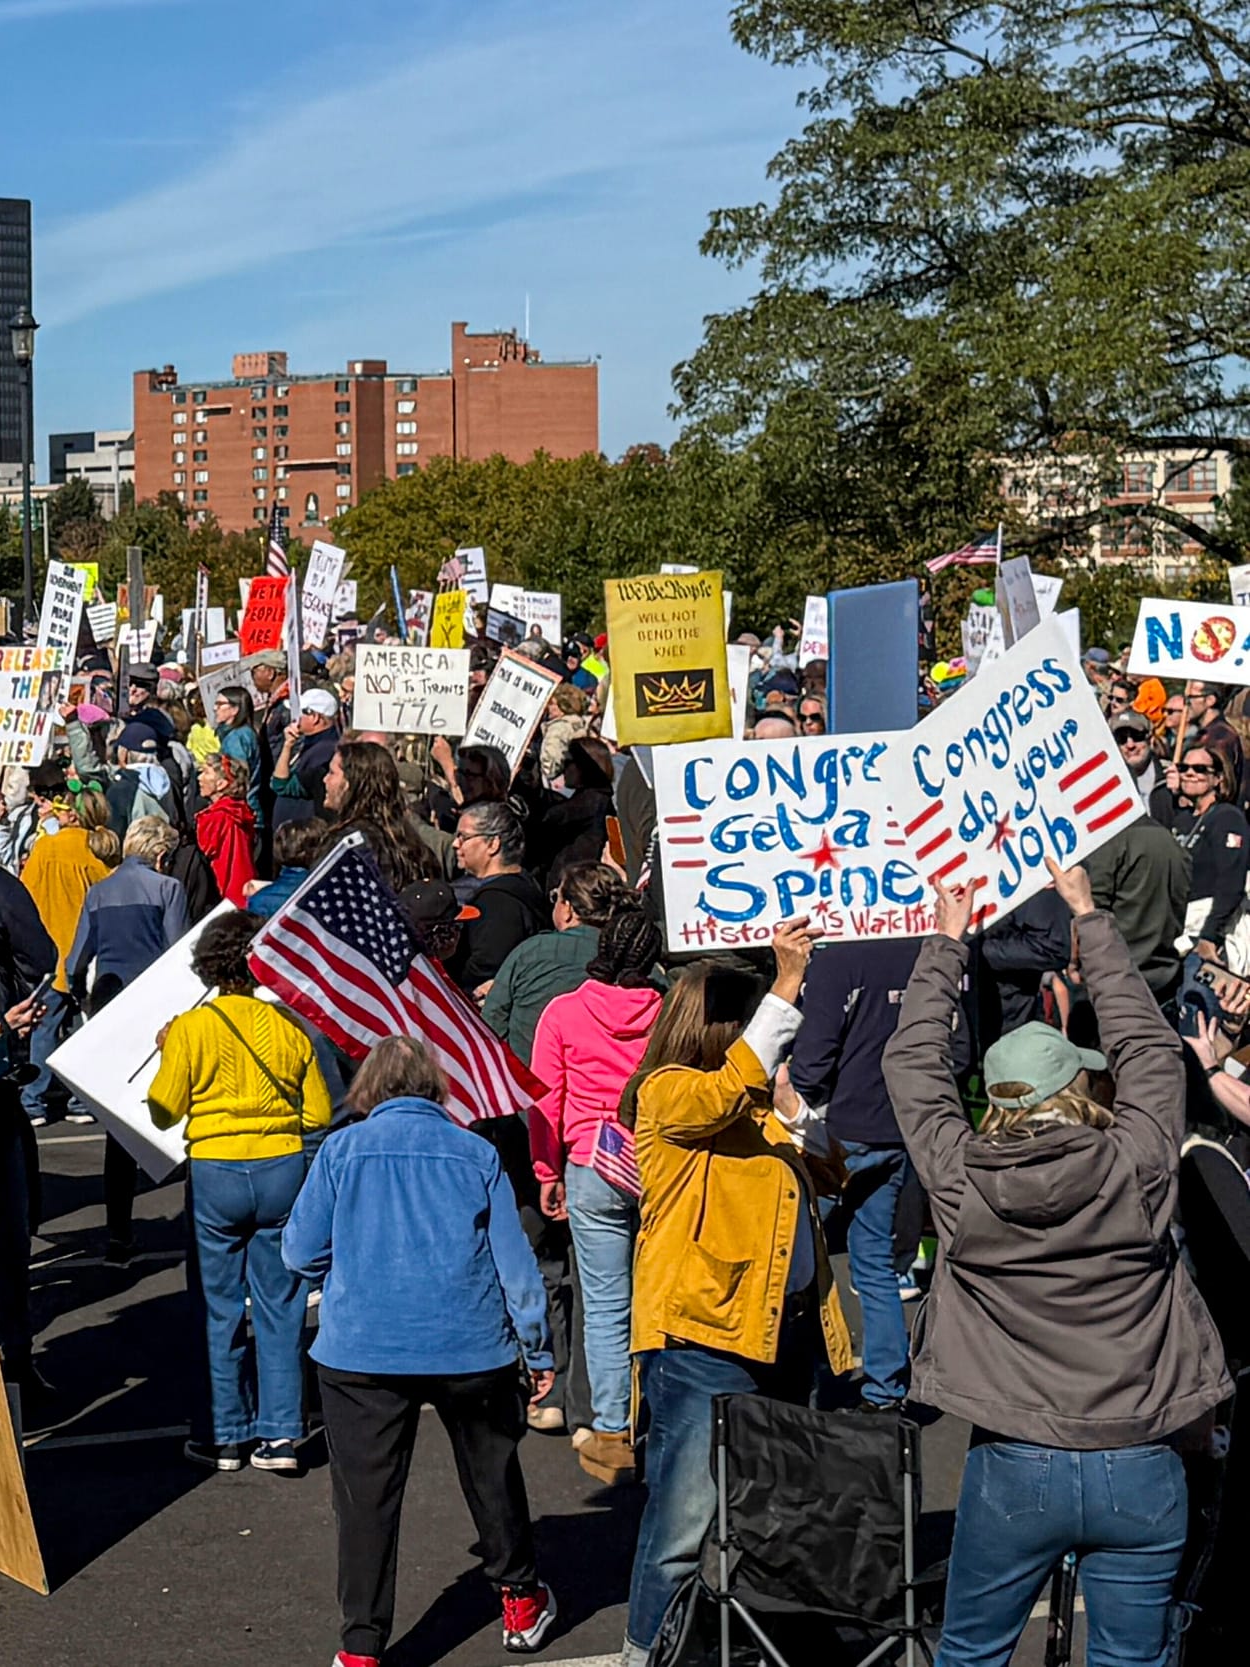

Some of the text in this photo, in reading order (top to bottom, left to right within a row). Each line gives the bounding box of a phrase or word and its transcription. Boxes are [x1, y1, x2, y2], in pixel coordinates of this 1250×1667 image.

[637, 610, 698, 624] WILL NOT
[637, 627, 700, 642] BEND THE
[364, 651, 449, 670] AMERICA
[654, 646, 686, 657] KNEE
[11, 674, 41, 699] THE
[377, 701, 447, 729] 1776
[913, 658, 1072, 798] Congress
[958, 719, 1078, 842] do your
[710, 802, 871, 853] Get a
[695, 859, 925, 923] Spine
